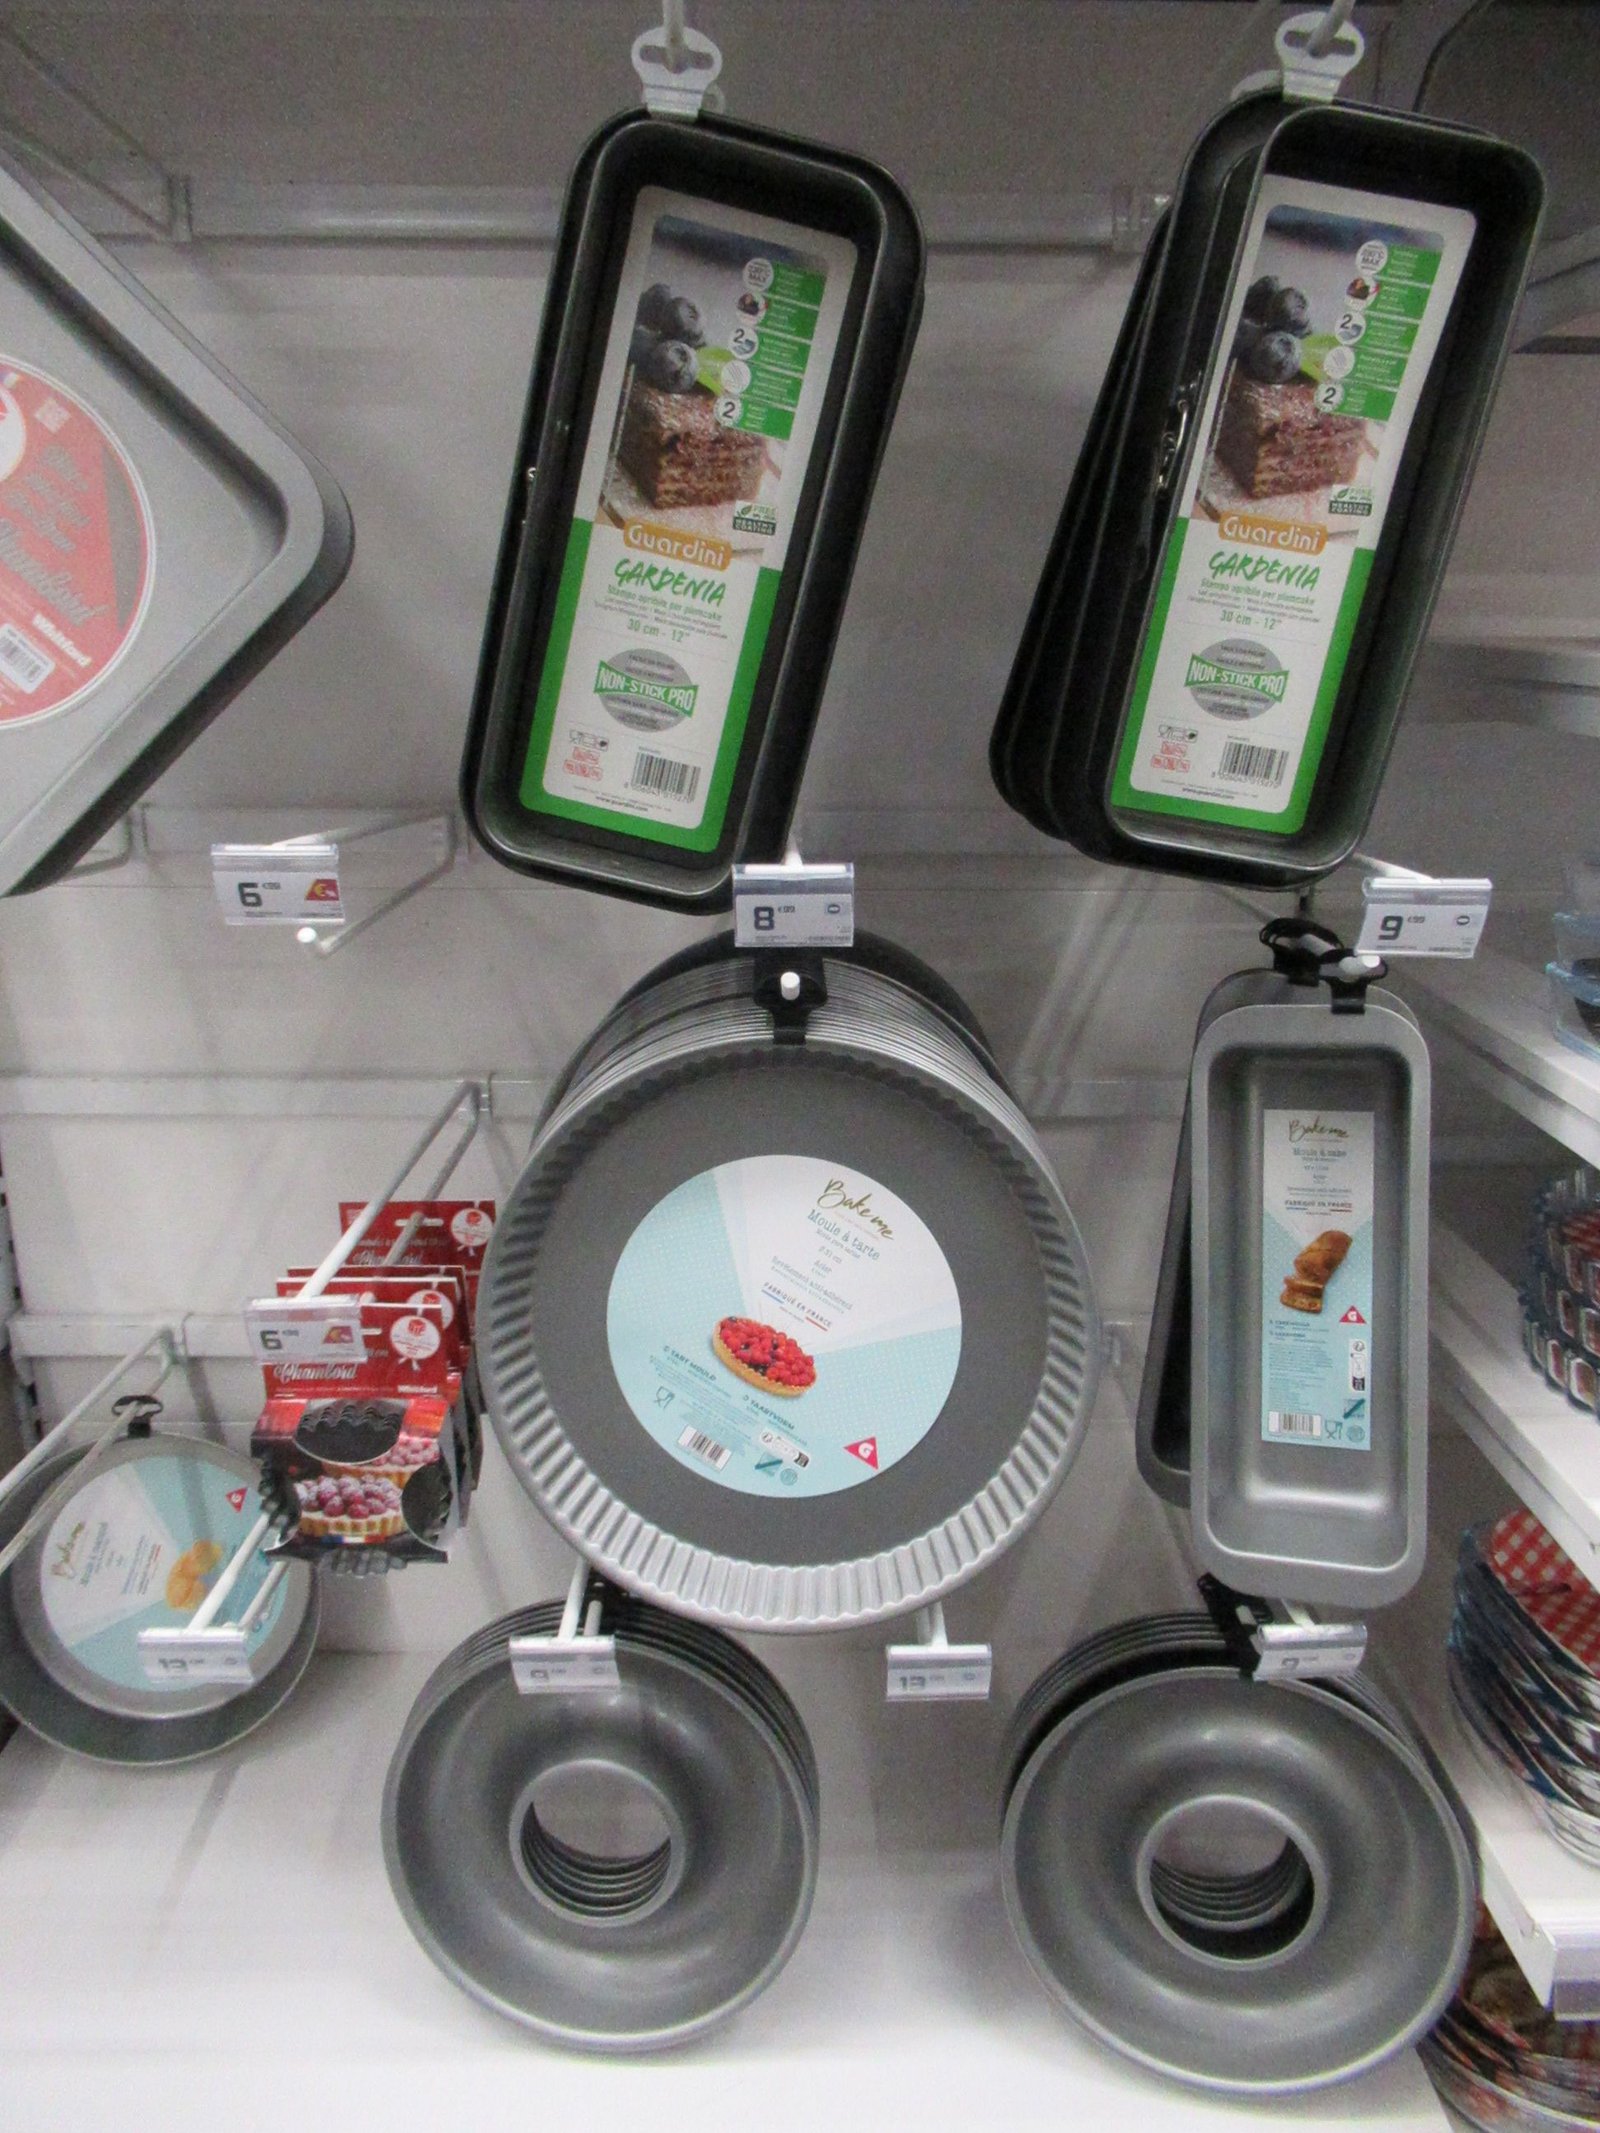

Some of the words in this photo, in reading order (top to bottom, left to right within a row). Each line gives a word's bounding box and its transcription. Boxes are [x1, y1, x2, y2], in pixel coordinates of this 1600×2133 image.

[1340, 314, 1353, 330] 2
[733, 328, 745, 343] 2
[1322, 387, 1337, 404] 2
[722, 401, 736, 419] 2
[627, 524, 726, 567] Guardini
[1222, 515, 1322, 551] Guardini
[613, 558, 727, 607] GARDENIA
[1208, 550, 1322, 592] GARDENIA
[626, 618, 641, 632] 30
[642, 625, 659, 637] cm
[1219, 609, 1234, 622] 30
[1235, 613, 1251, 625] cm
[597, 667, 666, 701] NON-STICK
[666, 688, 695, 712] PRO
[1188, 660, 1257, 687] NON-STICK
[1258, 672, 1286, 698] PRO
[237, 881, 263, 908] 6
[753, 906, 775, 931] 8
[1378, 915, 1404, 940] 9
[816, 1178, 875, 1219] Bake
[869, 1215, 895, 1241] me
[807, 1208, 841, 1236] Moule
[841, 1230, 850, 1243] à
[851, 1236, 881, 1262] tarte
[763, 1281, 798, 1306] FABRIQUÉ
[796, 1301, 807, 1313] EN
[805, 1308, 833, 1329] FRANCE
[1347, 1310, 1359, 1323] G
[259, 1329, 283, 1350] 6
[272, 1362, 358, 1385] Chambord
[857, 1444, 875, 1459] G
